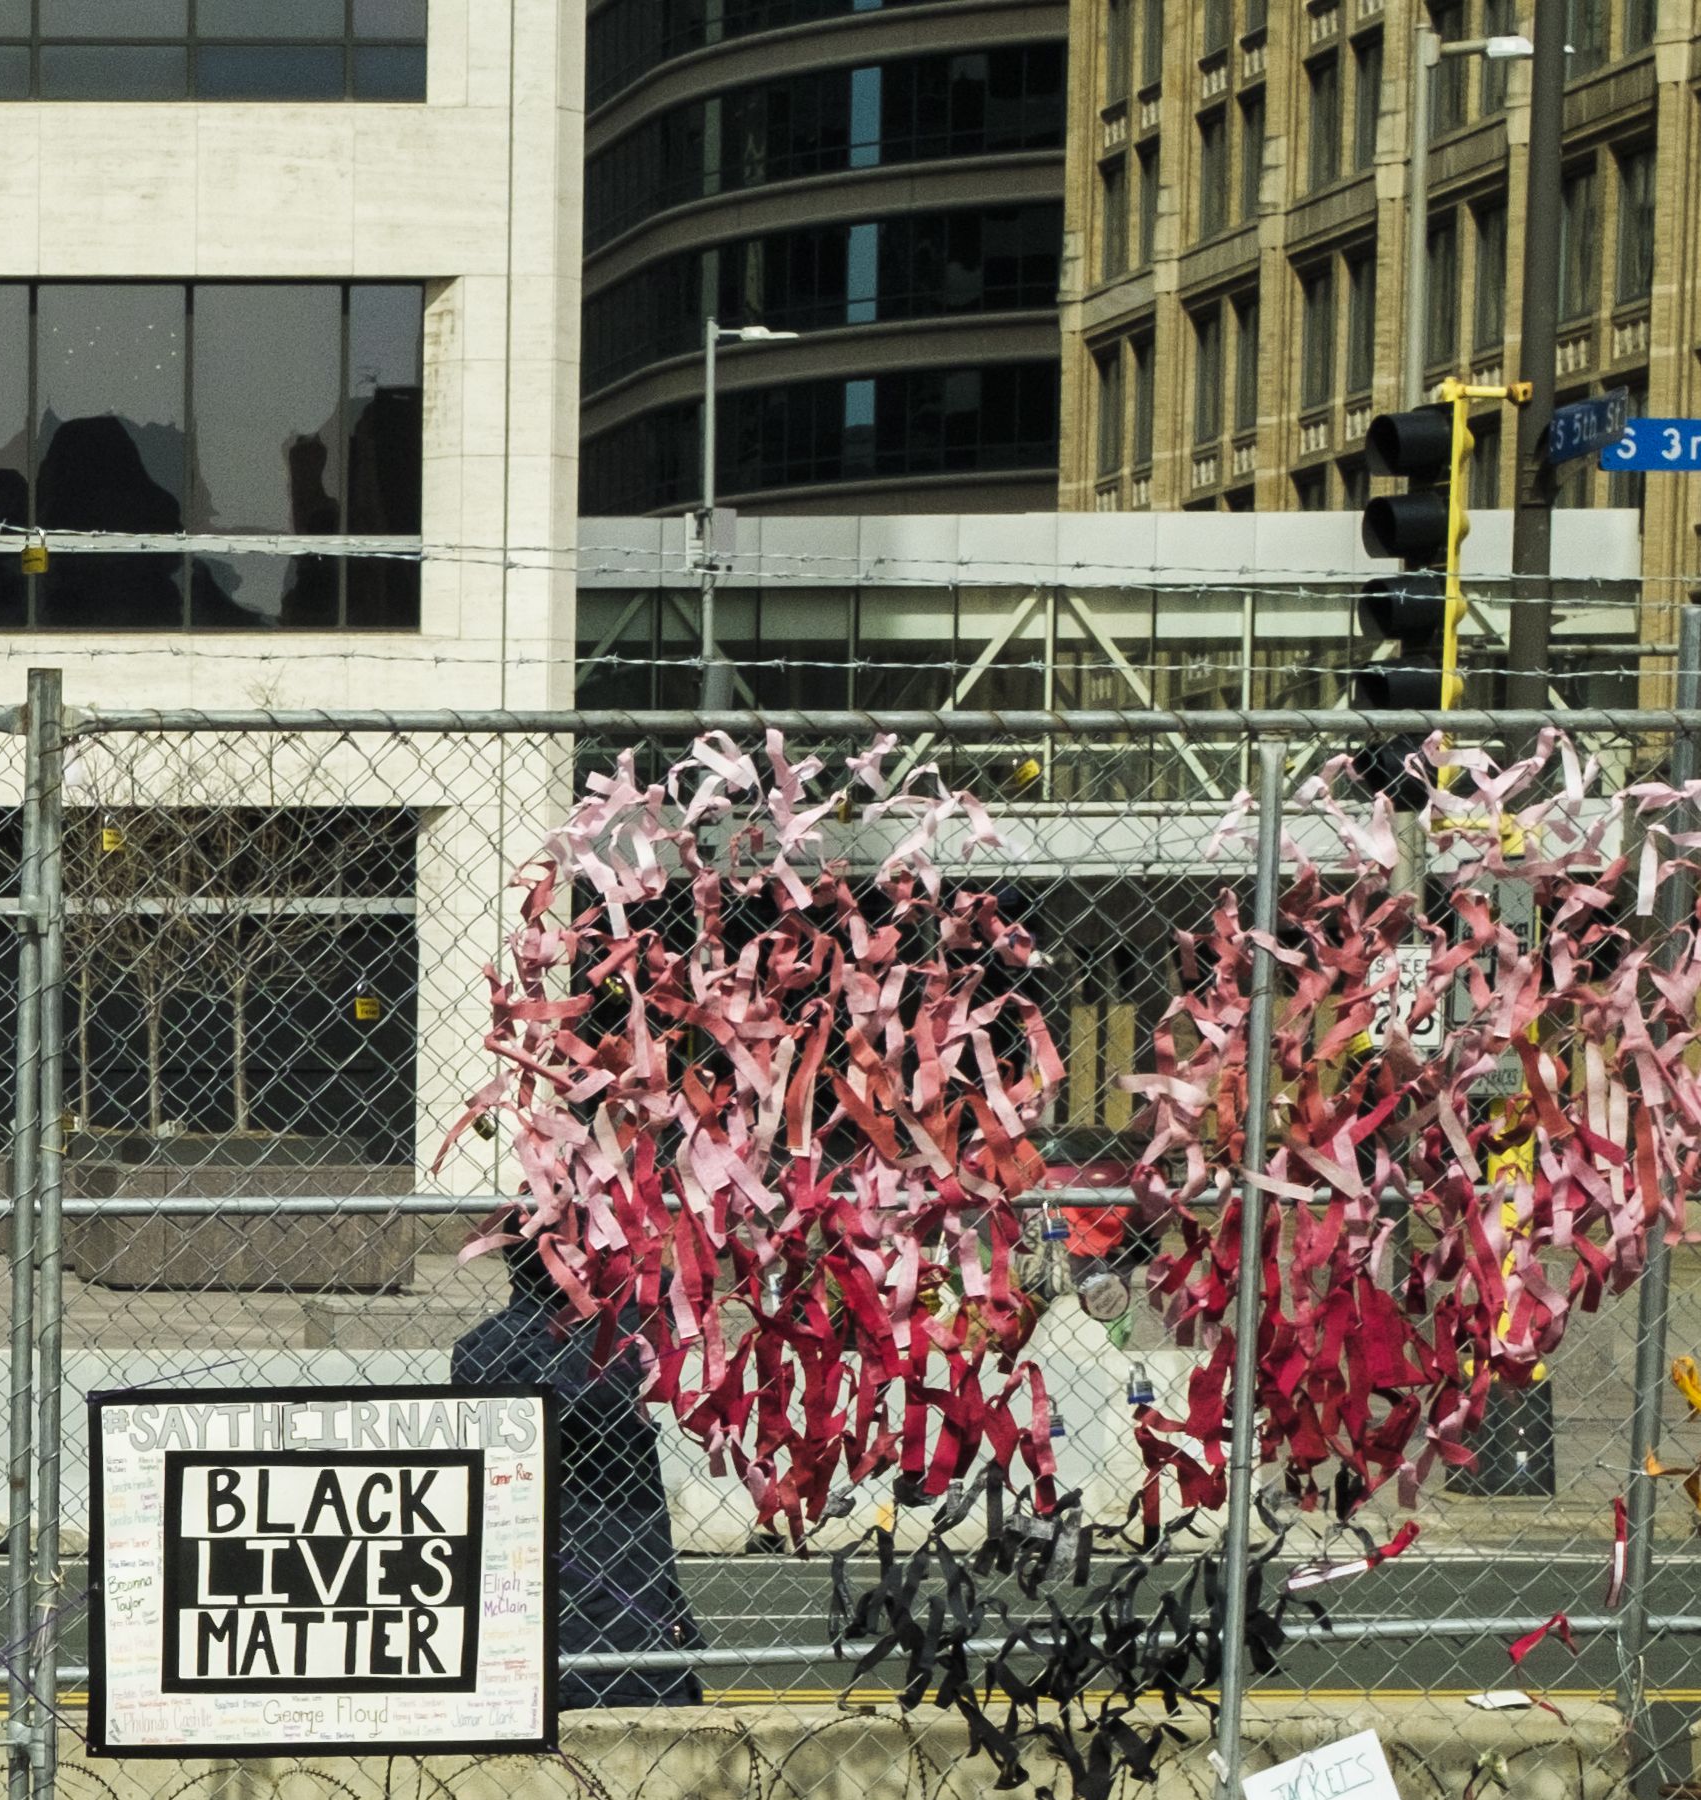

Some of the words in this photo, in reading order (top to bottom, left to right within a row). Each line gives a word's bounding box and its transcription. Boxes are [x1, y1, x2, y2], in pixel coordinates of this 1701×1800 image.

[1573, 413, 1597, 445] 5th
[1617, 427, 1636, 459] S
[101, 1397, 538, 1452] #SAYTHEIRNAMES
[206, 1468, 448, 1535] BLACK
[198, 1538, 452, 1606] LIVES
[483, 1571, 521, 1600] Elijah
[111, 1596, 145, 1619] Taylor
[484, 1599, 527, 1618] McClain
[196, 1606, 446, 1676] MATTER
[263, 1699, 324, 1734] George
[336, 1696, 388, 1738] Floyd
